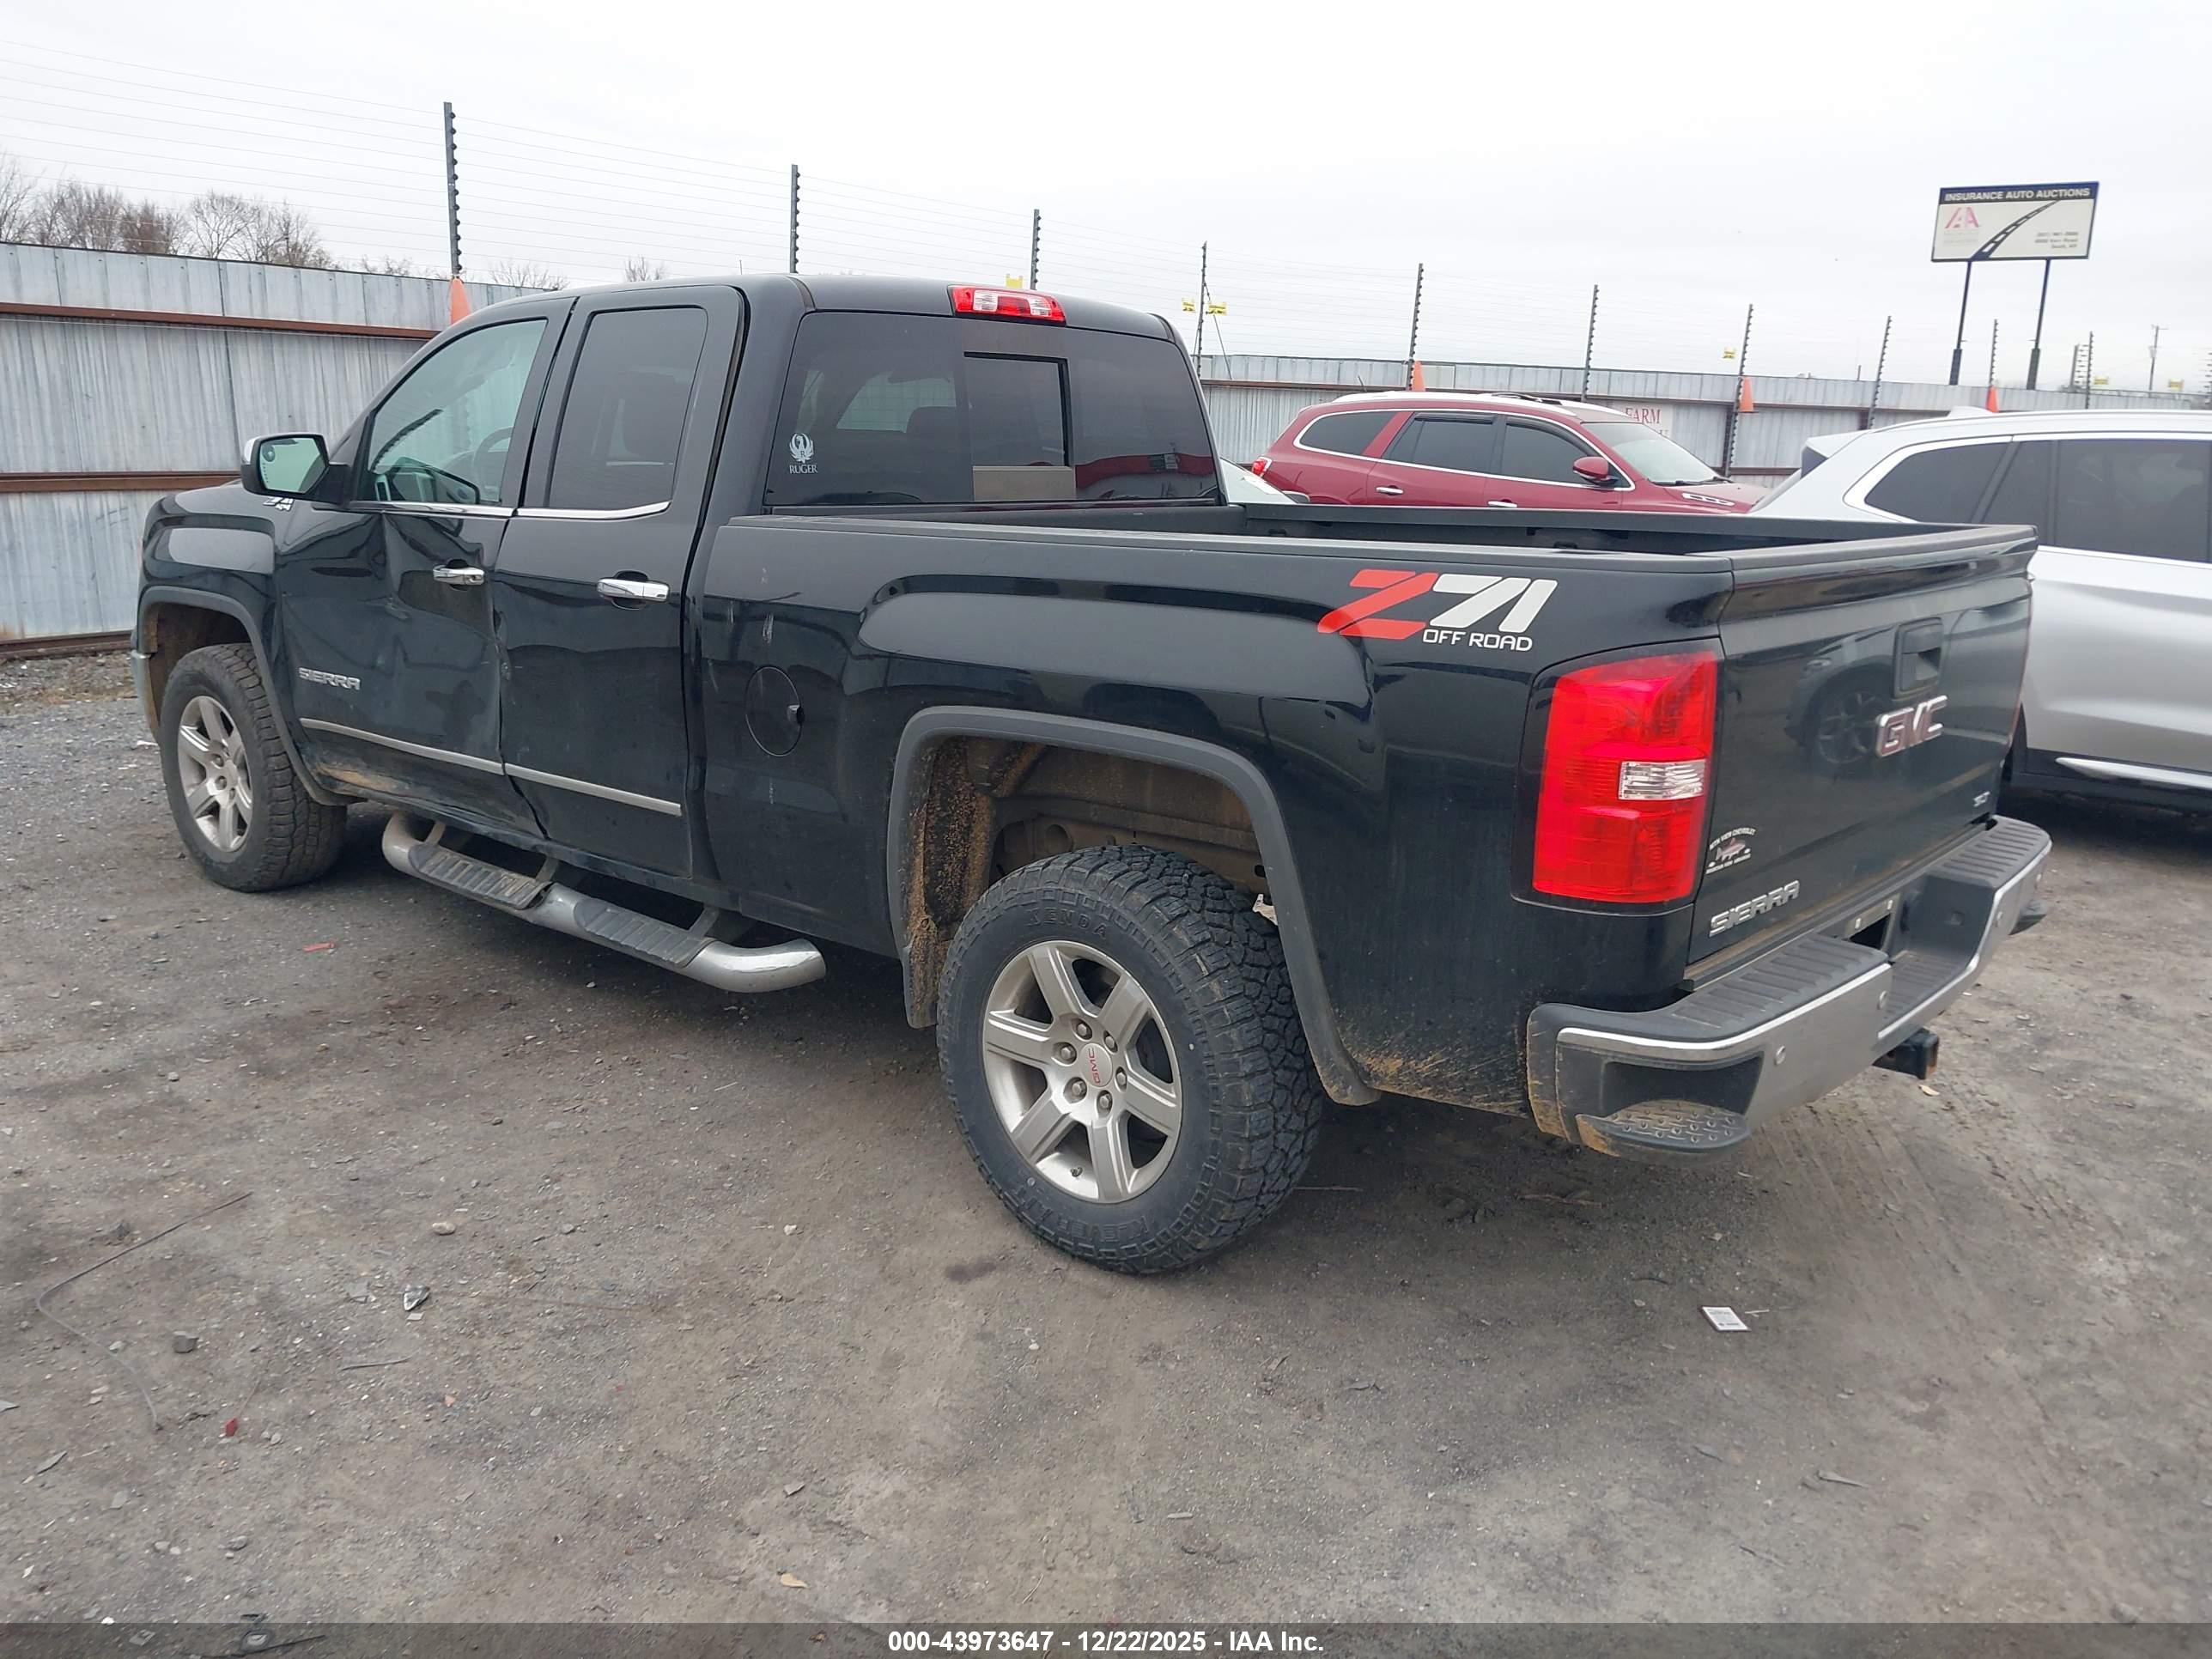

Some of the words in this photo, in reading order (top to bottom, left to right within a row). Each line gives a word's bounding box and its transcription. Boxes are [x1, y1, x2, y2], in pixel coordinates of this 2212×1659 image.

[1945, 191, 2003, 201] INSURANCE
[2005, 190, 2034, 199] AUTO
[2036, 187, 2090, 198] AUCTIONS
[789, 464, 818, 475] RUGER
[1317, 568, 1559, 641] Z71
[1422, 629, 1467, 646] OFF
[1468, 633, 1533, 652] ROAD
[298, 667, 362, 690] SIERRA
[1875, 695, 1948, 757] GMC
[1025, 906, 1108, 940] KENDA
[1709, 879, 1801, 938] SIERRA
[1087, 1047, 1101, 1084] GMC
